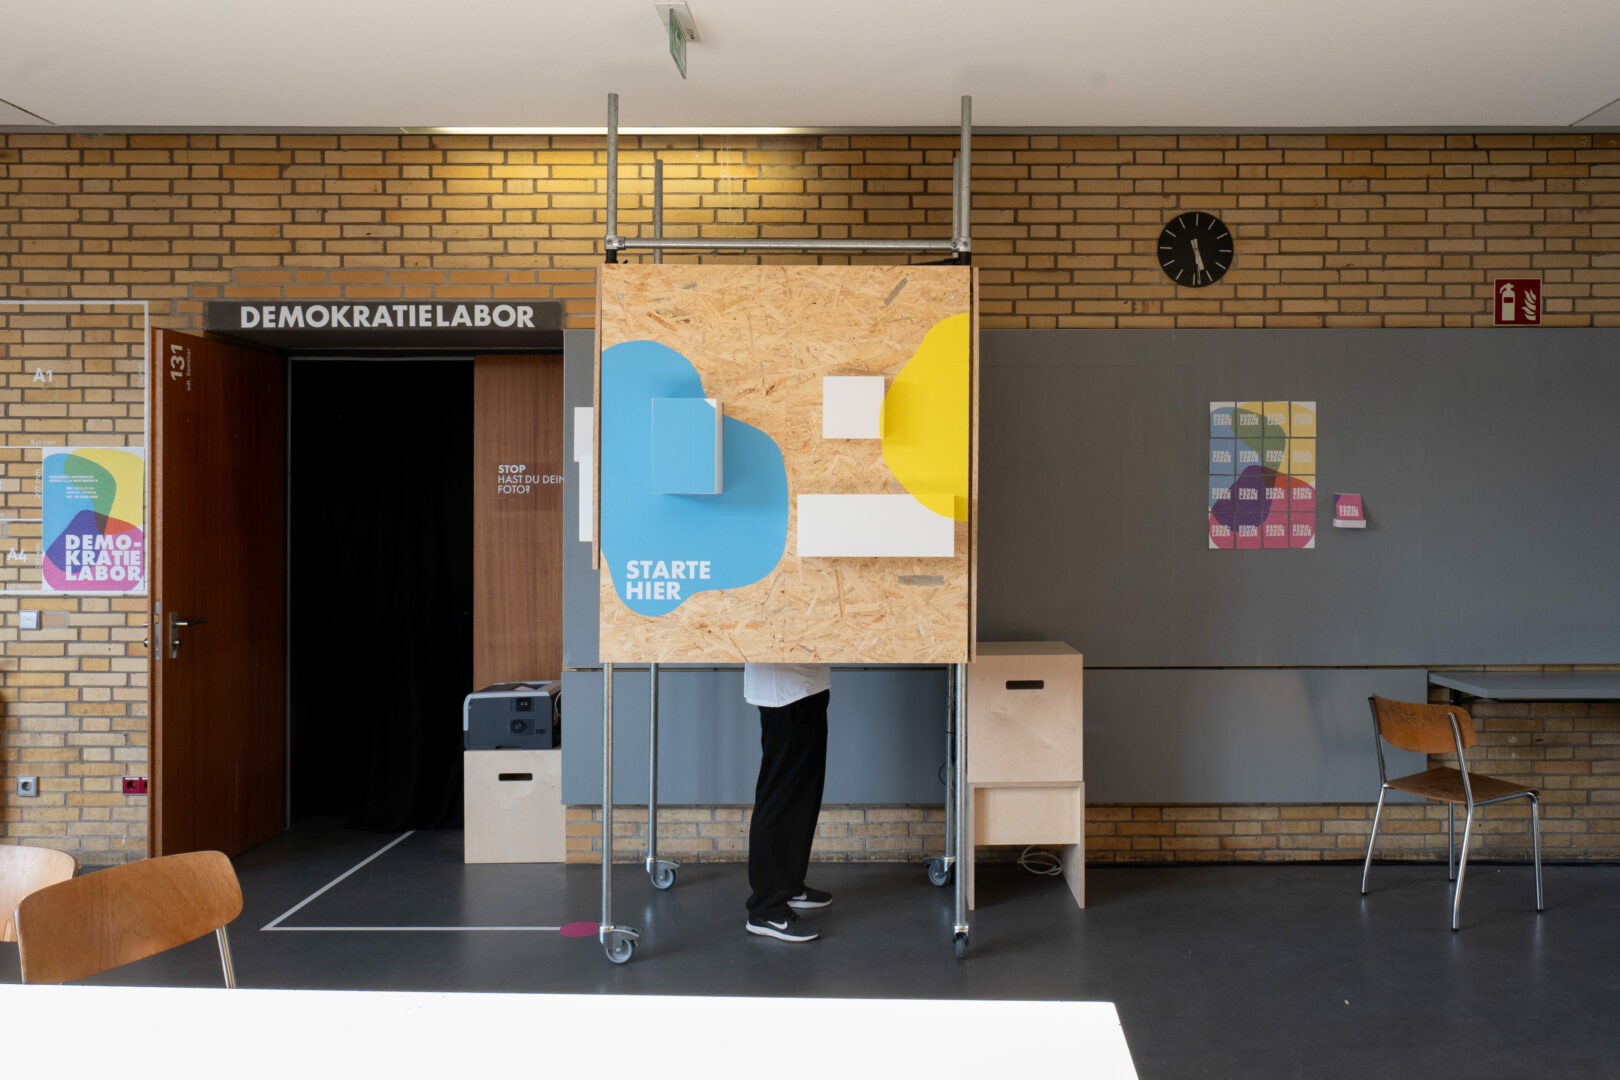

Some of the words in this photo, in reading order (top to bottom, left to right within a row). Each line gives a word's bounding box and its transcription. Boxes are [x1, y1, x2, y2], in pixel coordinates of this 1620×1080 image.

[240, 304, 535, 328] DEMOKRATIELABOR
[170, 343, 185, 381] 131
[33, 367, 54, 383] A1
[498, 464, 526, 474] STOP
[497, 474, 524, 484] HAST
[525, 474, 540, 484] DU
[497, 484, 531, 494] FOTO?
[65, 534, 142, 550] DEMO-
[7, 546, 28, 563] A4
[65, 550, 141, 566] KRATIE
[65, 565, 142, 581] LABOR
[626, 560, 711, 580] STARTE
[626, 581, 682, 600] HIER
